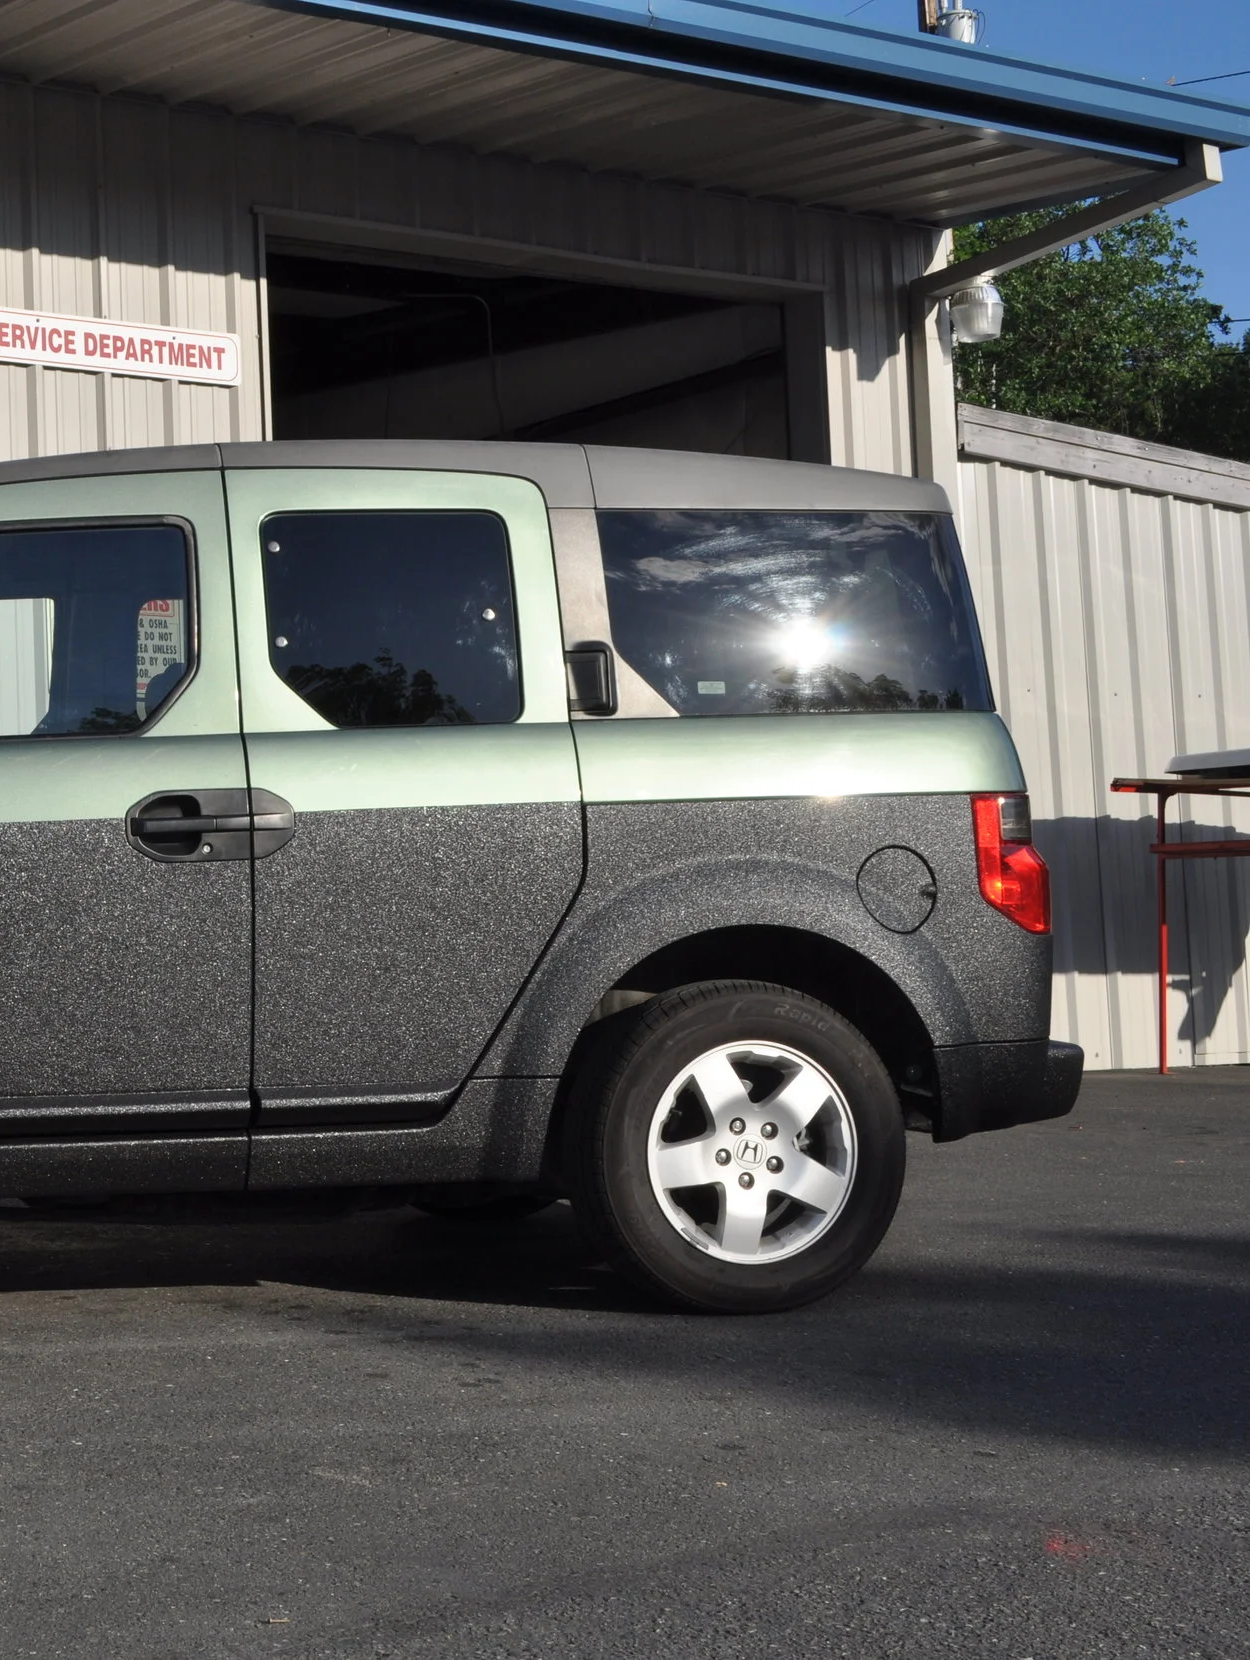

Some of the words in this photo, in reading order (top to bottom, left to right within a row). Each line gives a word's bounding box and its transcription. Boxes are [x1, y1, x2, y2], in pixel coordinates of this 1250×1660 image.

[84, 332, 226, 371] DEPARTMENT
[141, 600, 170, 612] RS
[149, 618, 168, 629] OSHA
[145, 631, 155, 641] DO
[159, 632, 173, 642] NOT
[137, 643, 149, 653] EA
[153, 643, 177, 655] UNLESS
[150, 657, 158, 666] BY
[136, 668, 151, 679] OR.
